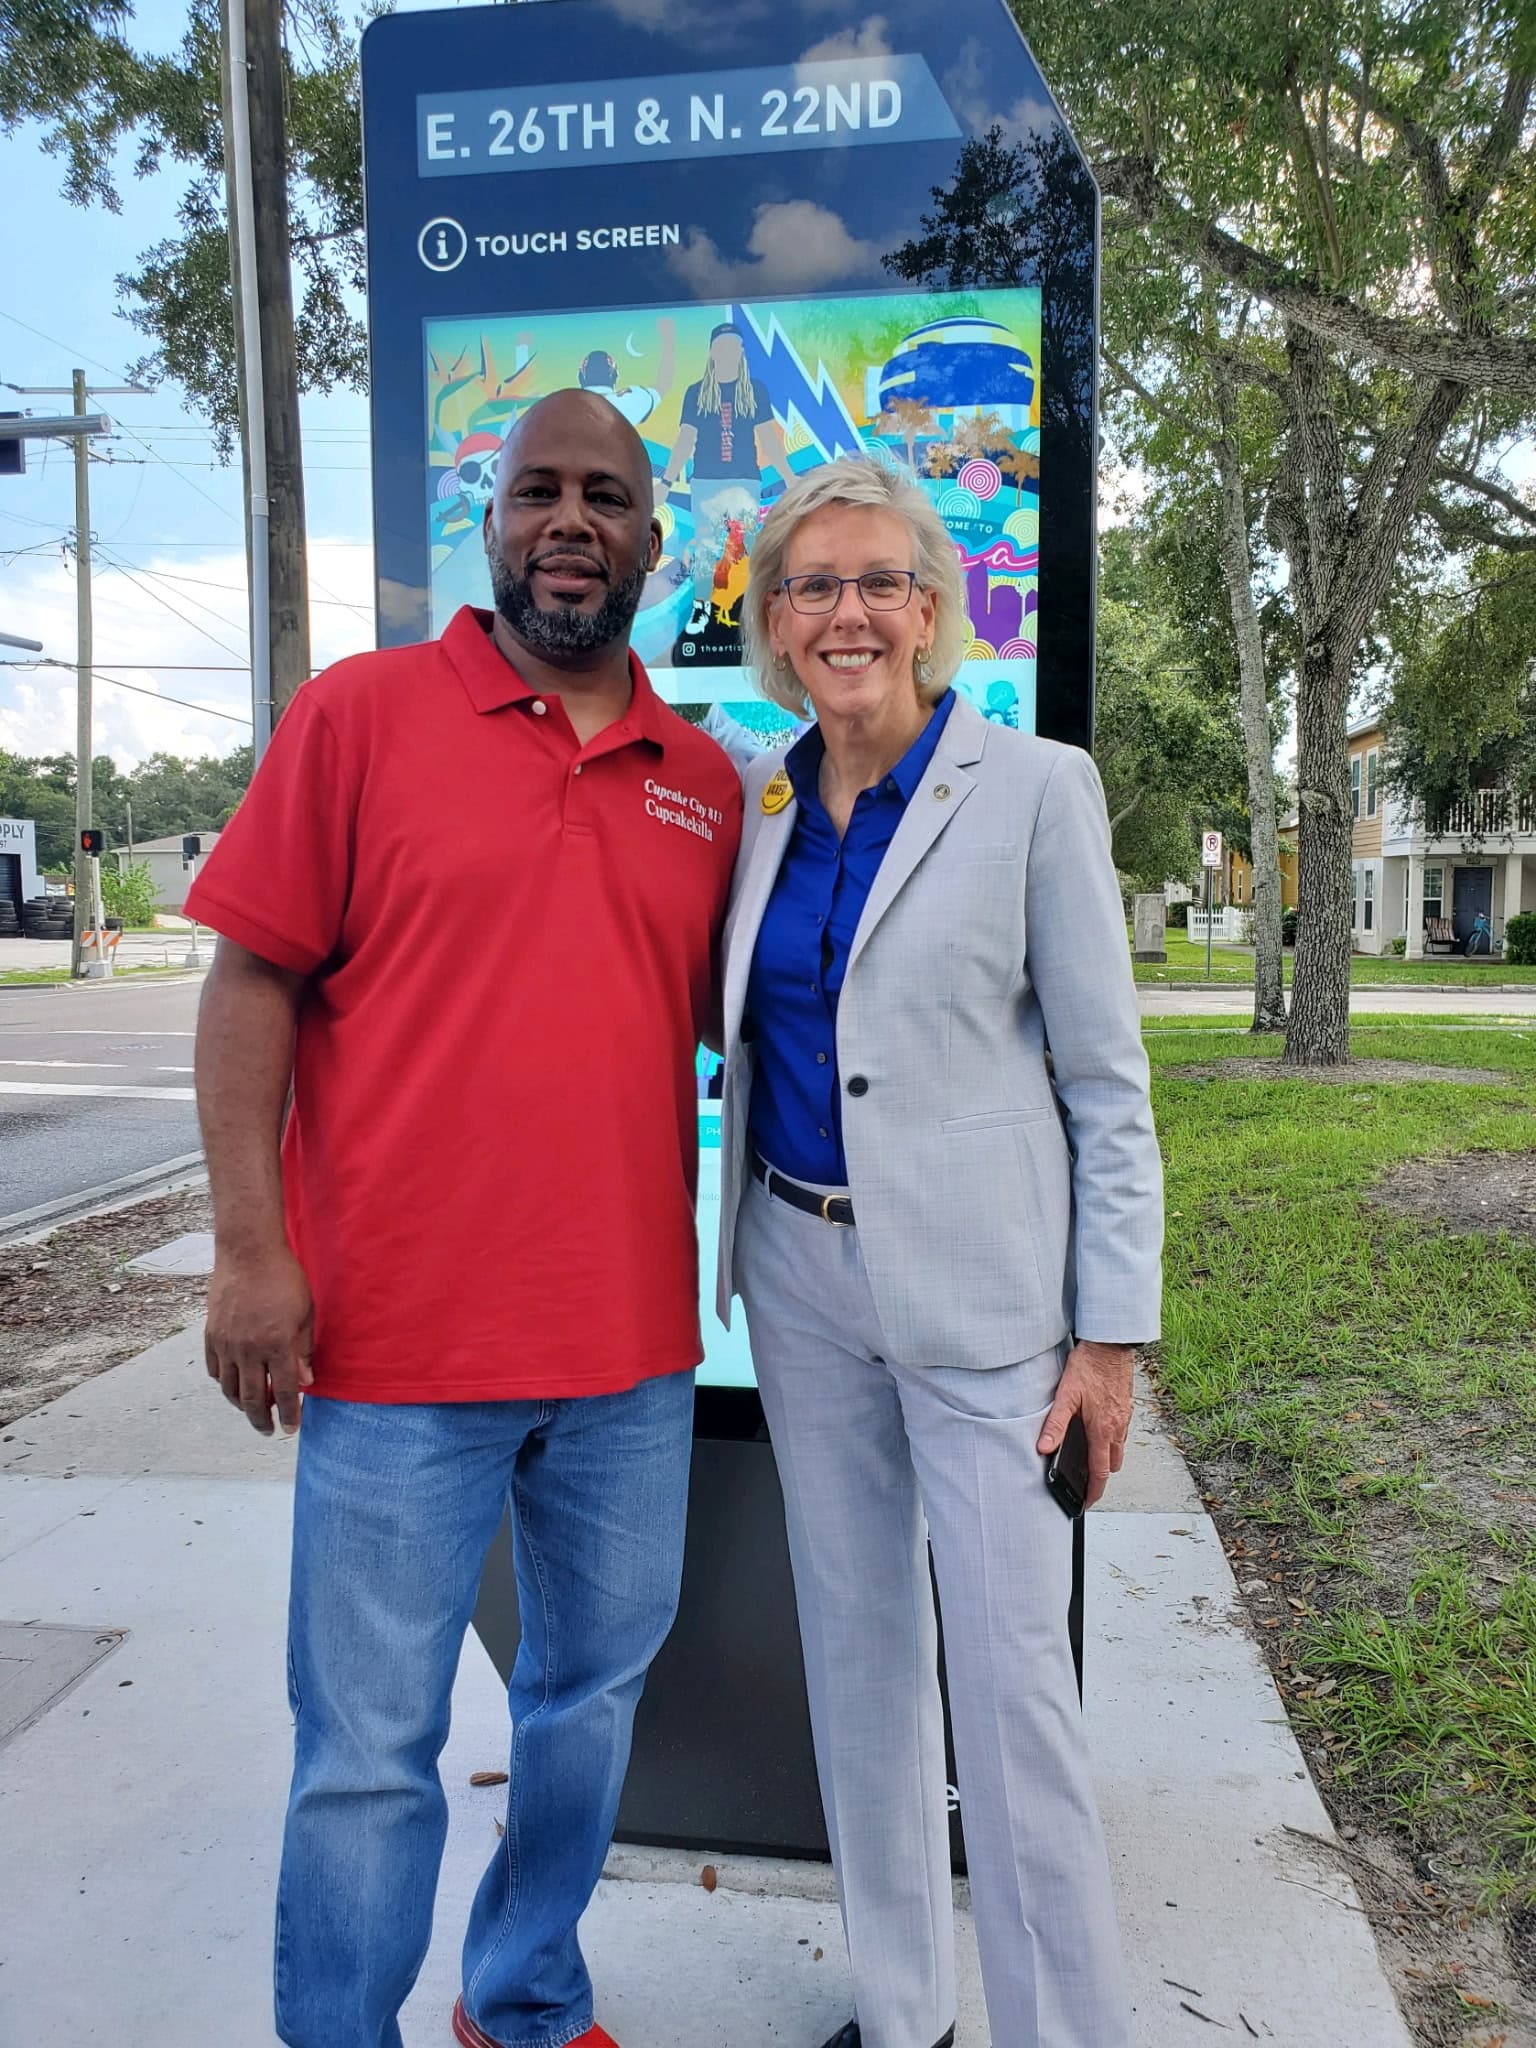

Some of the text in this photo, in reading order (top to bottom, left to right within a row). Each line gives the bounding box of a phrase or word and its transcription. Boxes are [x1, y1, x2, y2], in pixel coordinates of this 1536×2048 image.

[427, 79, 902, 160] E. 26TH & N. 22ND
[475, 223, 680, 257] TOUCH SCREEN
[979, 523, 993, 534] TO
[644, 778, 723, 825] Cupcake City 813
[645, 798, 713, 842] Cupcakekilla
